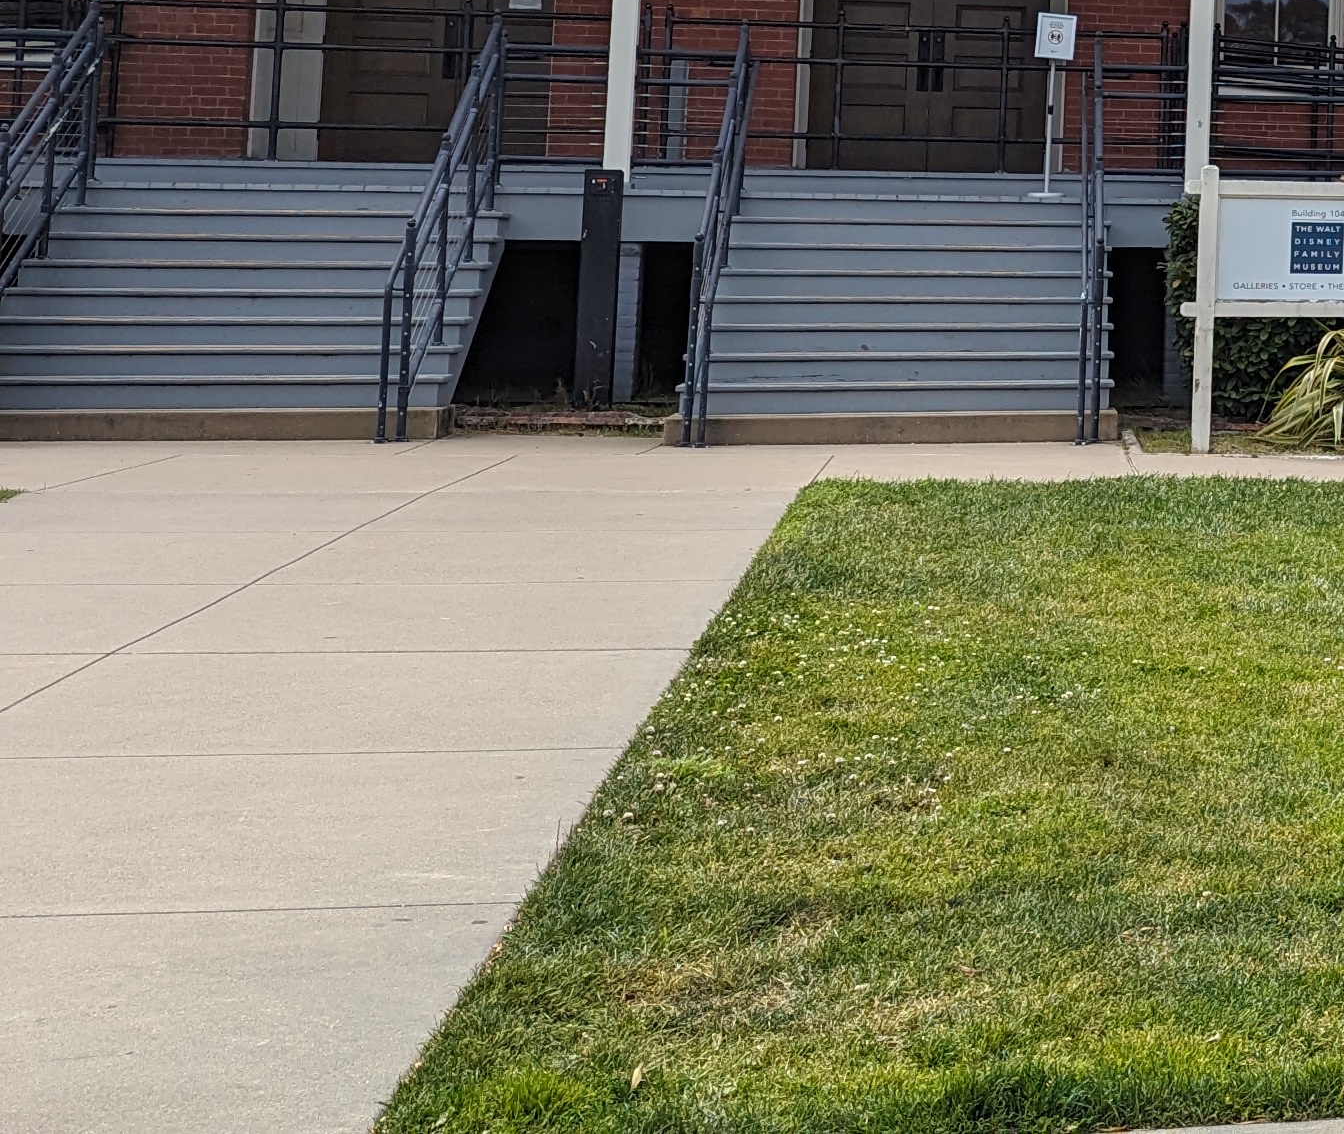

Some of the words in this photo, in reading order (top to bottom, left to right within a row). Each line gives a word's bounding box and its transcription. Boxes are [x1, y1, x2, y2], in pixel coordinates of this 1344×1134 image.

[1291, 209, 1327, 219] Building
[1293, 250, 1341, 258] FAMILY
[1293, 263, 1340, 271] MUSEUM
[1233, 282, 1279, 290] GALLERIES
[1288, 282, 1317, 290] STORE
